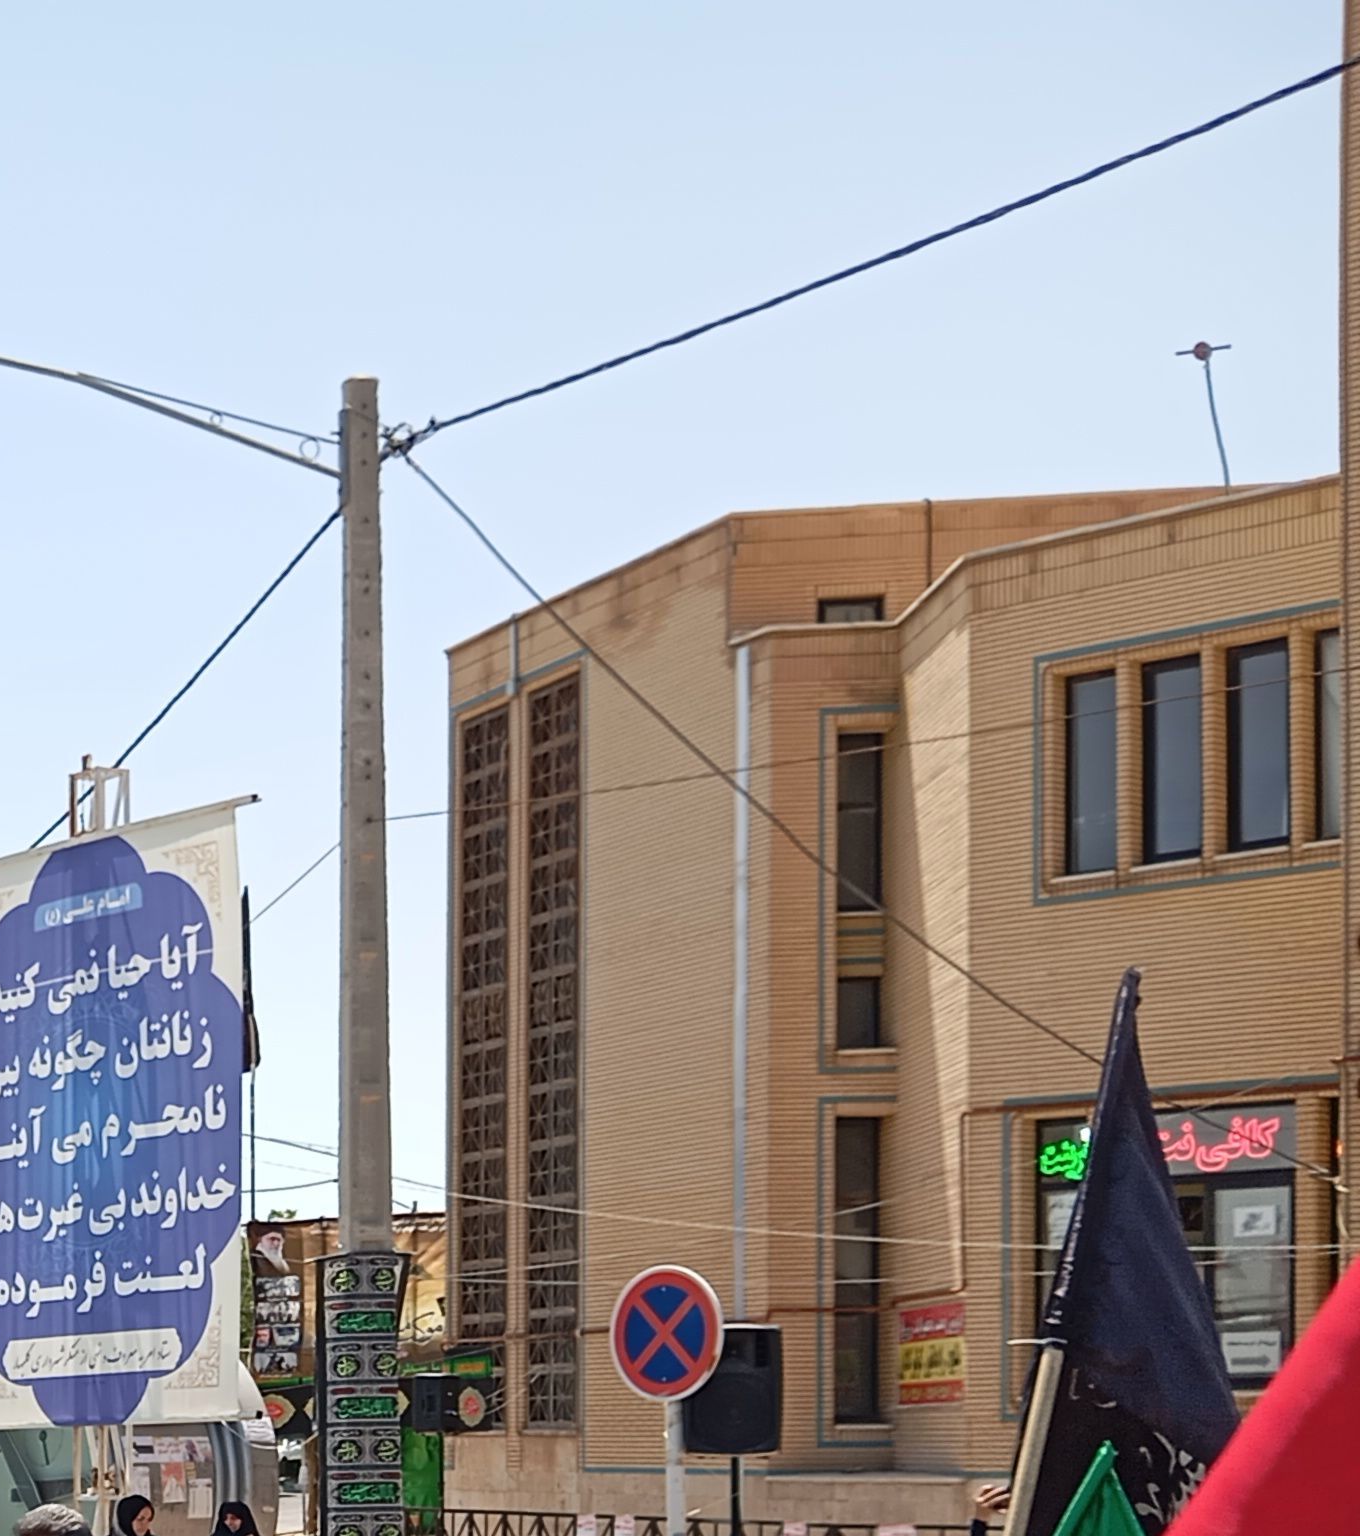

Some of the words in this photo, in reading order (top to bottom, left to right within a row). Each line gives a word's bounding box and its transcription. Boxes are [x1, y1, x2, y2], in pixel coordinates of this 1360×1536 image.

[63, 896, 97, 924] علی
[96, 888, 131, 916] امام
[47, 948, 100, 1015] نمی
[107, 944, 151, 1000] حیا
[160, 922, 203, 990] آیا
[28, 1029, 107, 1091] چگونه
[115, 1010, 212, 1079] زنانتان
[52, 1121, 92, 1164] می
[101, 1084, 226, 1158] نامحرم
[1196, 1116, 1280, 1172] کافی
[89, 1188, 127, 1235] بی
[130, 1163, 237, 1228] خداوند
[113, 1243, 207, 1297] لعنت
